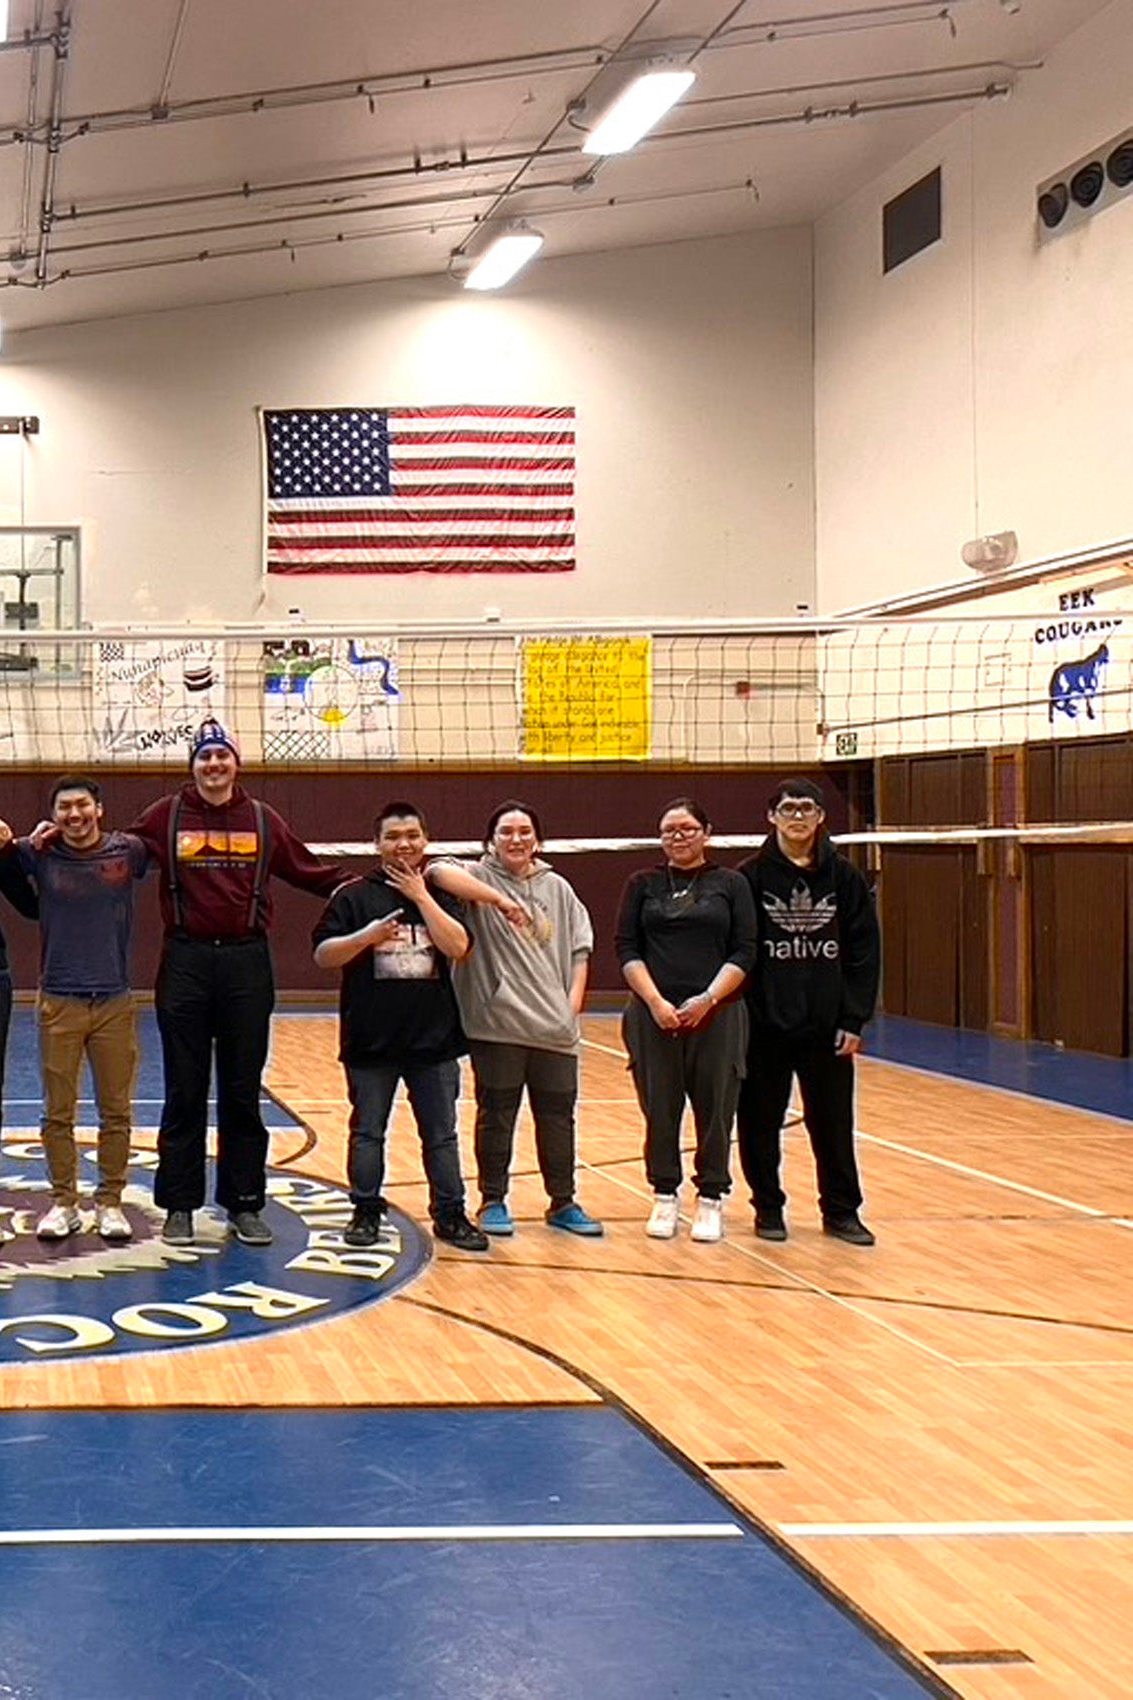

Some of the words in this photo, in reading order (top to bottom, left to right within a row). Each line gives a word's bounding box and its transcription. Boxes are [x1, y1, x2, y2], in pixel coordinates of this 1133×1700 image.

[1059, 588, 1095, 611] EEK
[1035, 618, 1123, 644] COUGA
[764, 935, 839, 959] native
